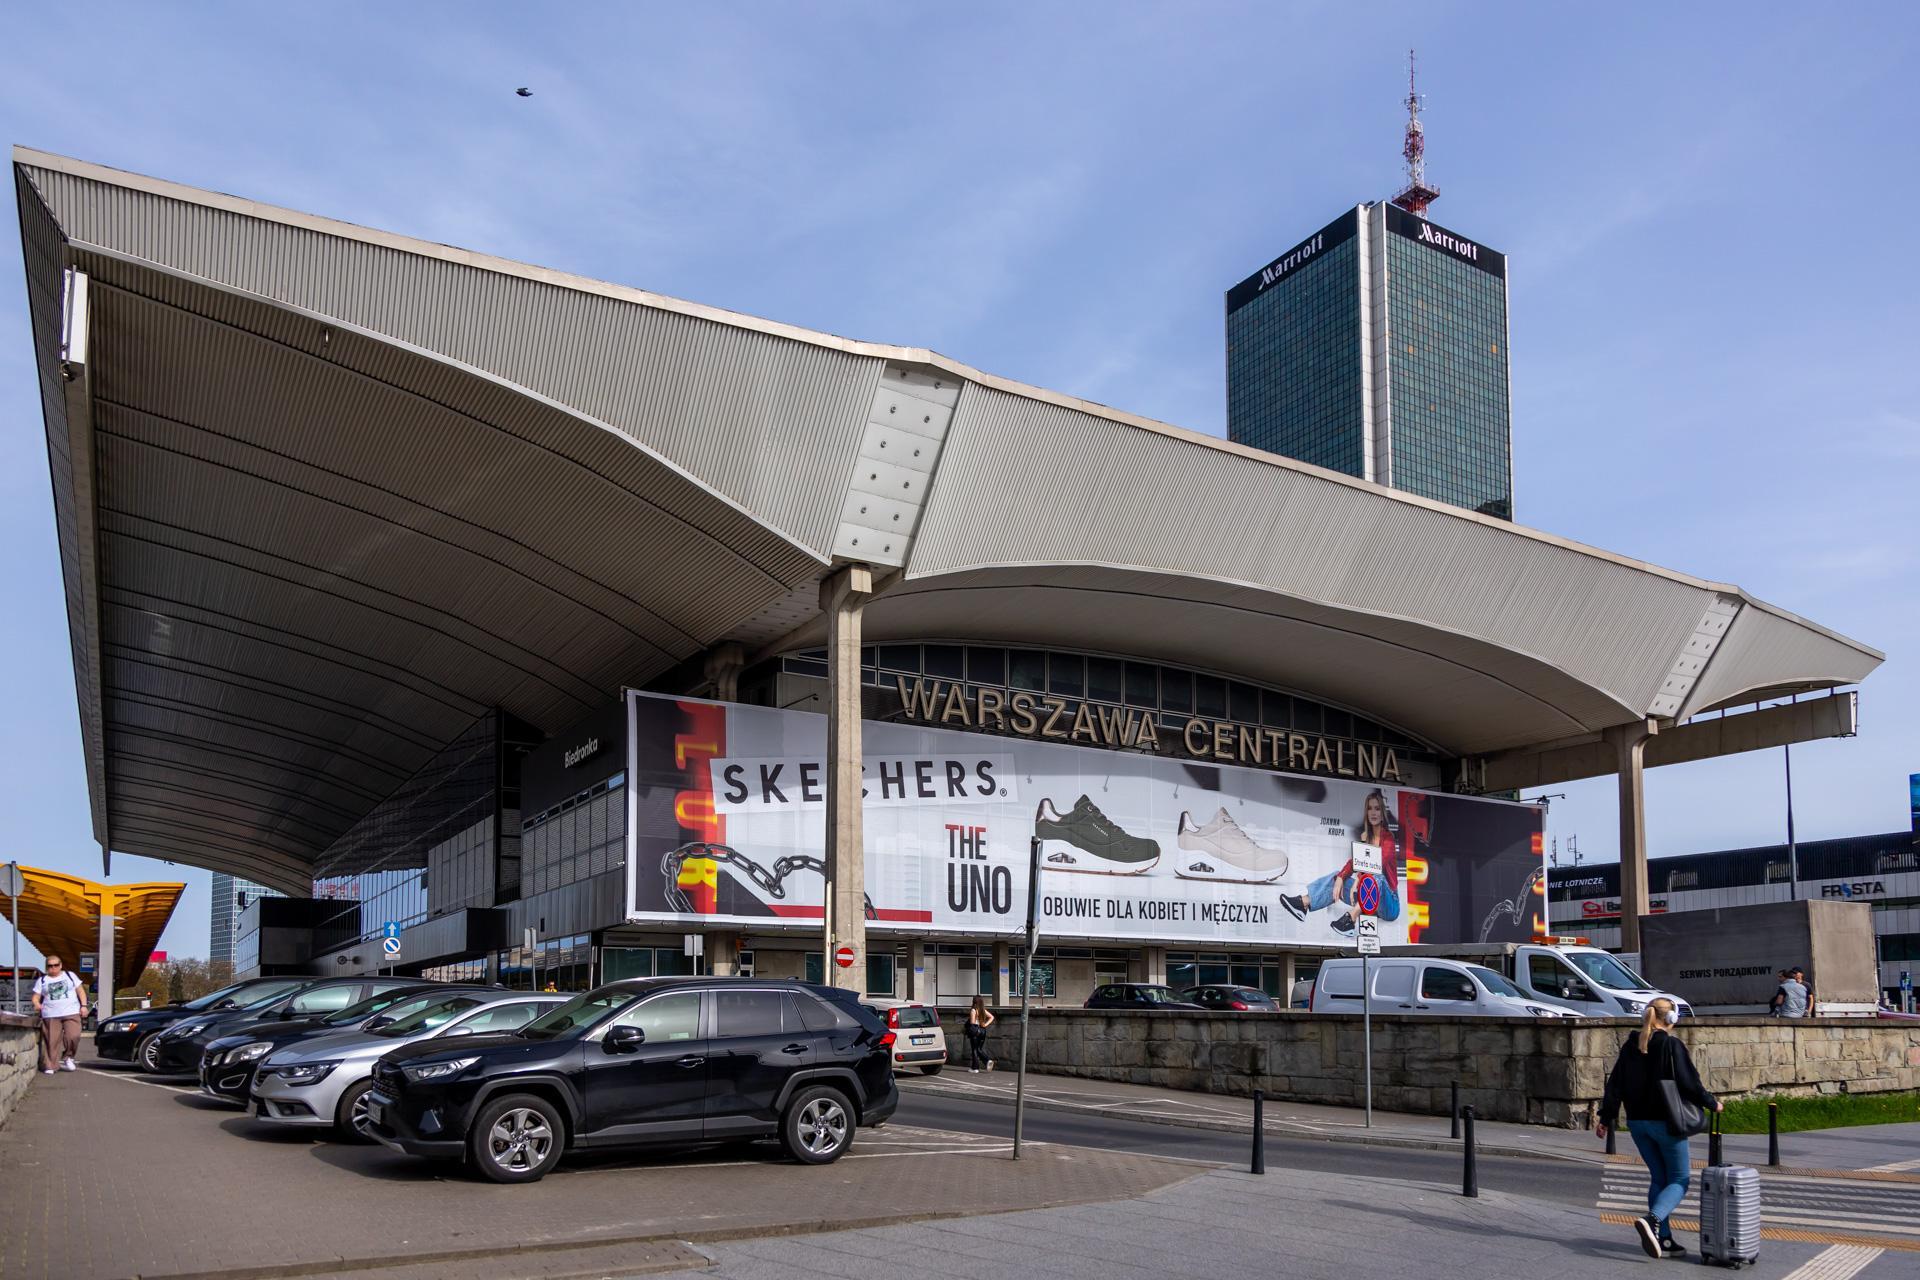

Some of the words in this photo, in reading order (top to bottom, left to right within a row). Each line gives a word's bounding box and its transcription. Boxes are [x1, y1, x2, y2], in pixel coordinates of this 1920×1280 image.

[1418, 223, 1478, 261] Marriott
[1258, 233, 1323, 291] Marriott
[896, 675, 1160, 750] WARSZAWA
[1184, 717, 1401, 782] CENTRALNA
[564, 737, 599, 769] Biedronka
[945, 824, 987, 860] THE
[947, 863, 1012, 914] UNO
[1565, 877, 1604, 888] LOTNICZE
[1043, 896, 1101, 918] OBUWIE
[1107, 899, 1133, 919] DLA
[1139, 901, 1187, 921] KOBIET
[1192, 903, 1197, 921] I
[1202, 900, 1268, 925] MĘŻCZYZN
[1680, 968, 1711, 979] SERWIS
[1713, 966, 1772, 979] PORZĄDKOWY
